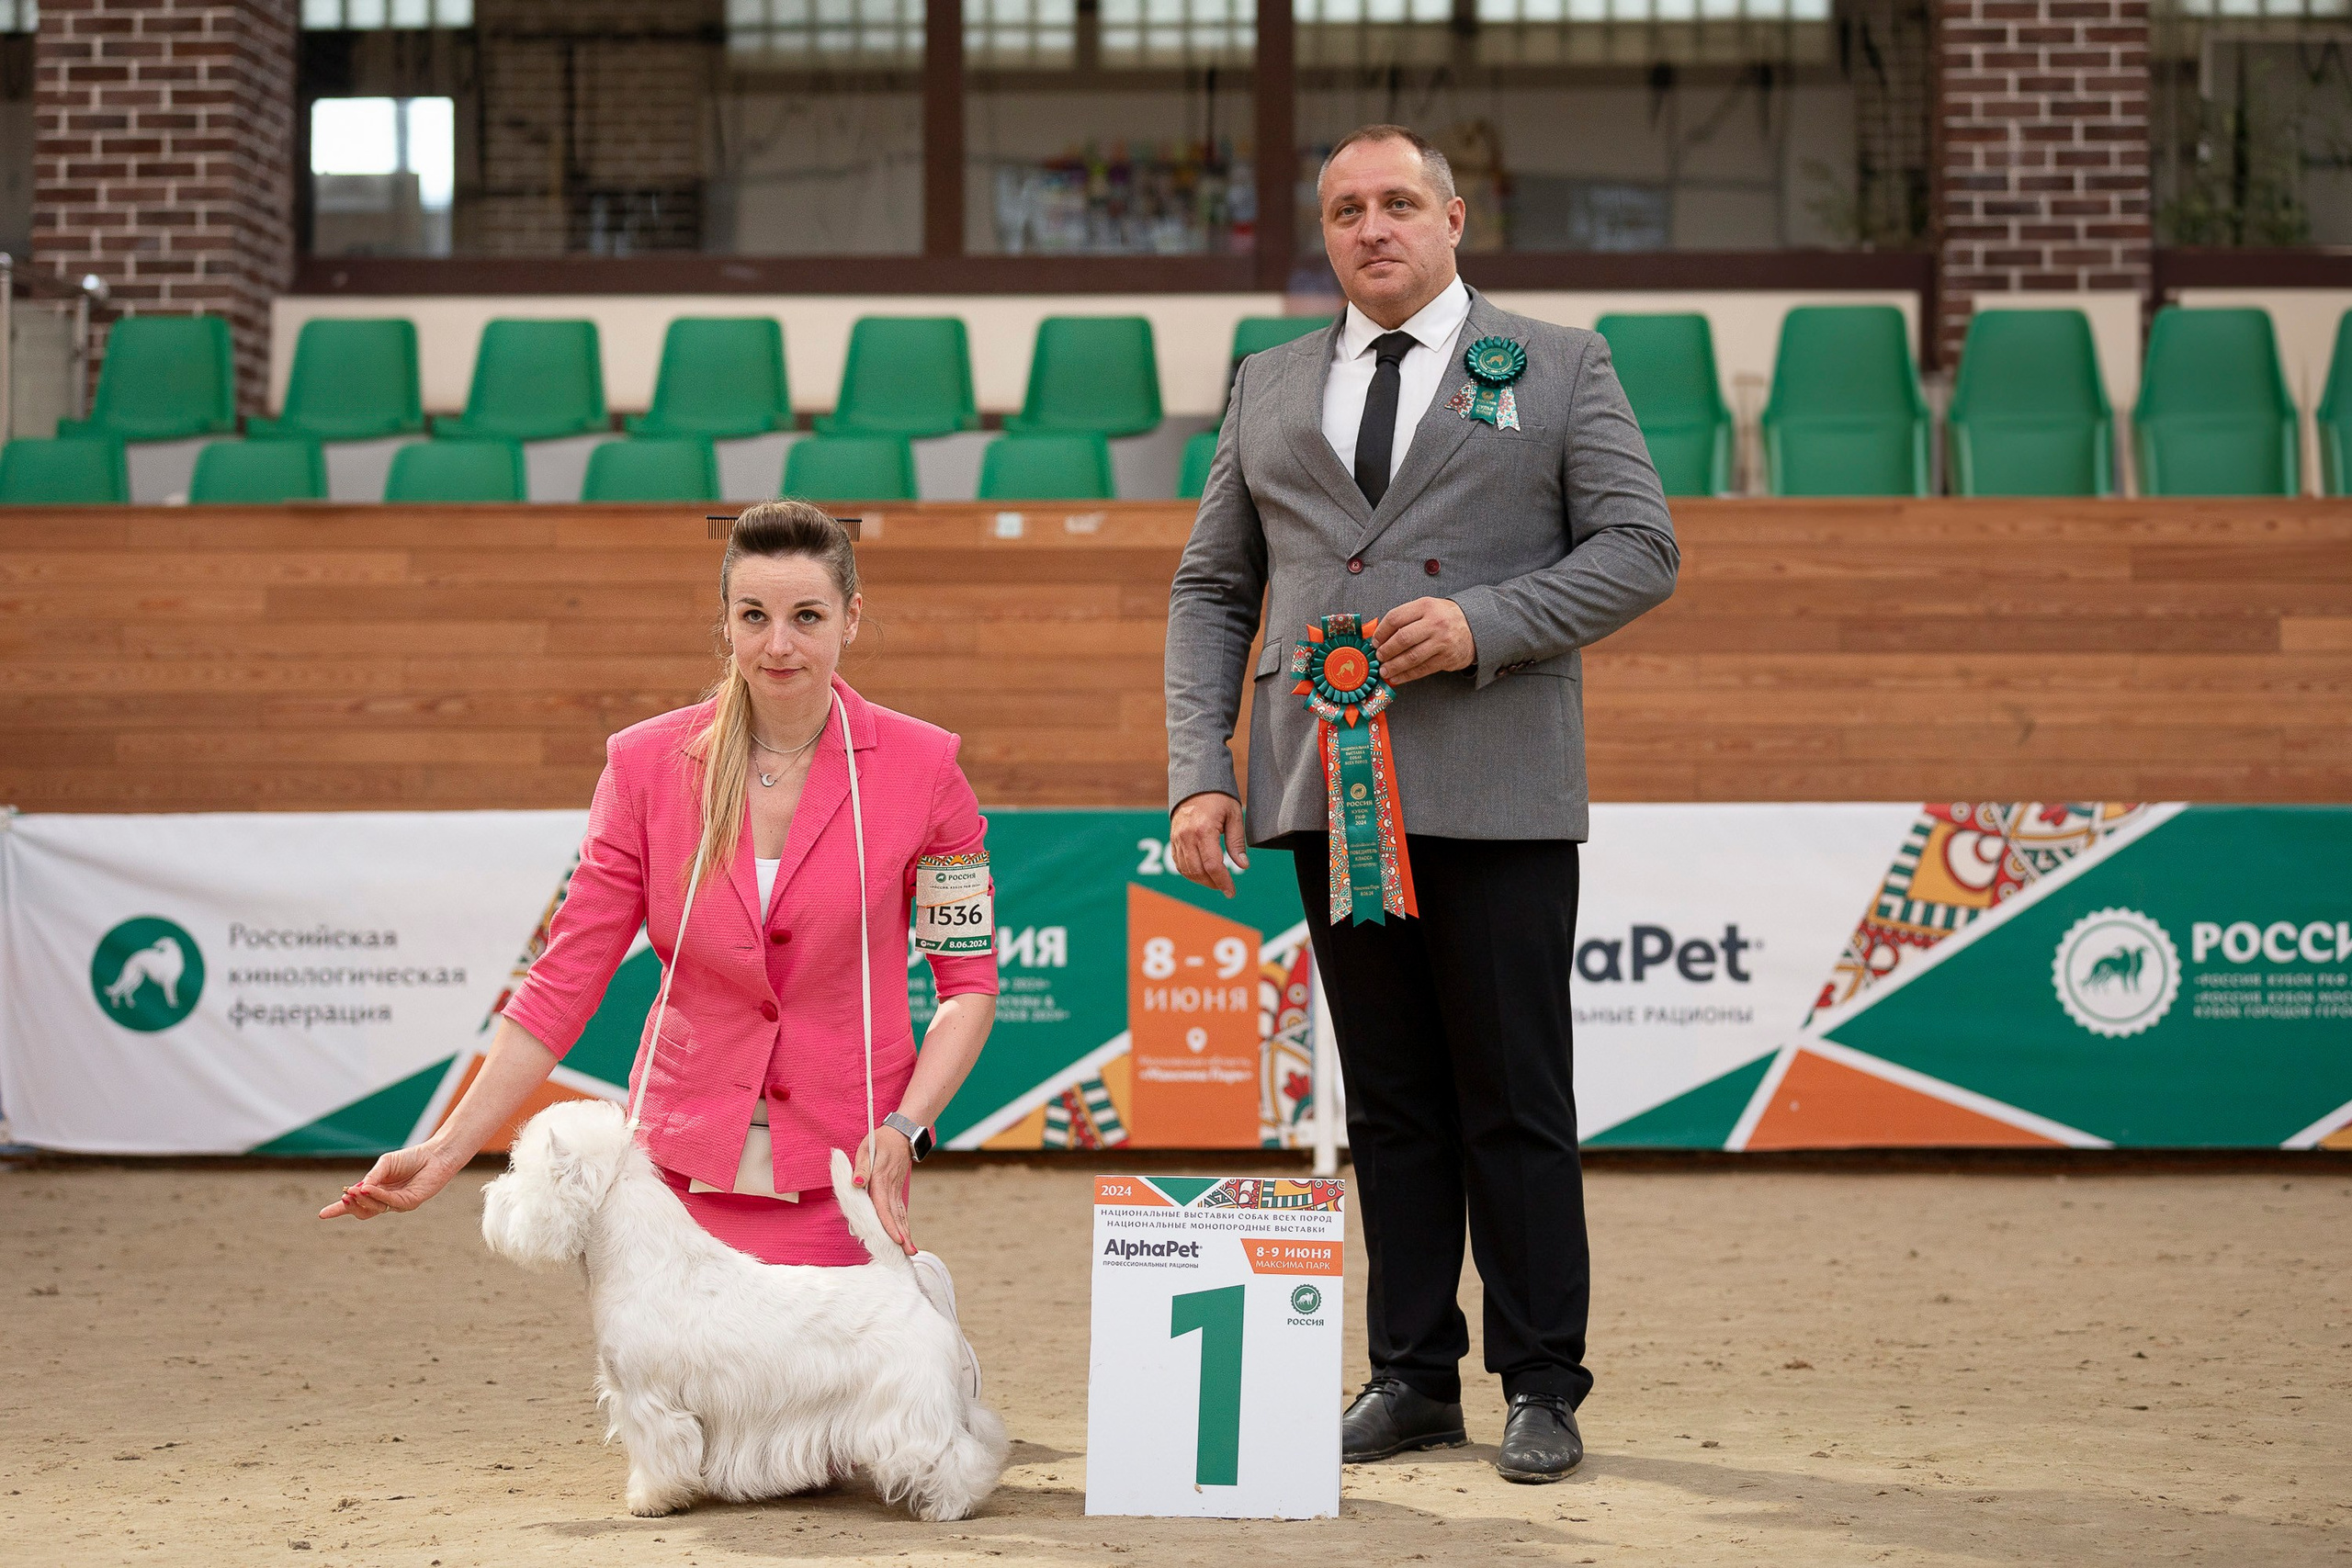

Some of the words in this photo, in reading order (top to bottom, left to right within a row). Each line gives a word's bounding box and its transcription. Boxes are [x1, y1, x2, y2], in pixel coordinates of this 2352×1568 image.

[926, 904, 982, 926] 1536
[229, 922, 398, 950] Российская
[949, 940, 987, 948] 8.06.2024
[1577, 924, 1751, 984] aPet
[228, 967, 467, 987] кинологическая
[1144, 987, 1249, 1012] ИЮНЯ
[228, 998, 393, 1030] федерация
[1101, 1185, 1132, 1196] 2024
[1101, 1209, 1181, 1217] НАЦИОНАЛЬНЫЕ
[1107, 1221, 1186, 1229] НАЦИОНАЛЬНЫЕ
[1191, 1223, 1271, 1232] МОНОПОРОДНЫЕ
[1104, 1239, 1199, 1259] AlphaPet
[1256, 1247, 1280, 1257] 8-9
[1284, 1247, 1331, 1258] ИЮНЯ
[1255, 1260, 1304, 1269] МАКСИМА
[1170, 1284, 1245, 1486] 1
